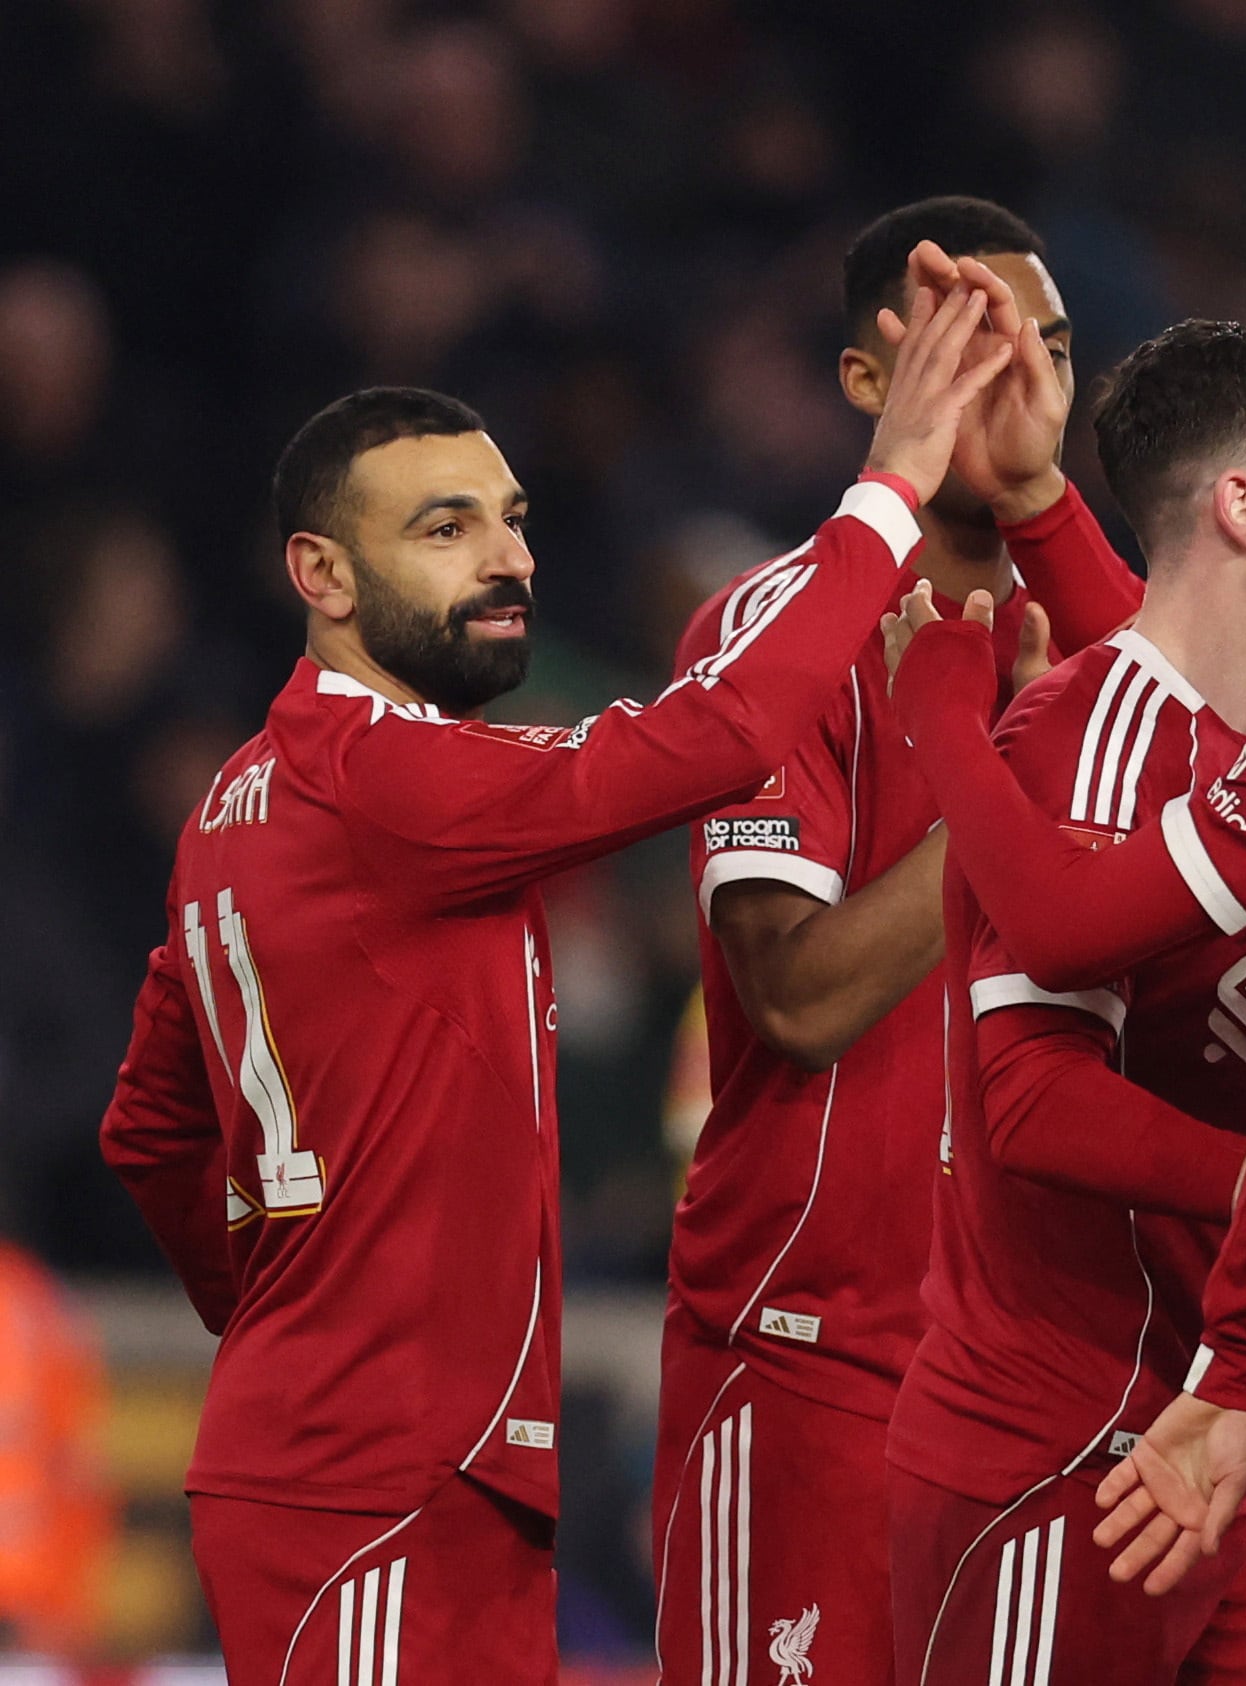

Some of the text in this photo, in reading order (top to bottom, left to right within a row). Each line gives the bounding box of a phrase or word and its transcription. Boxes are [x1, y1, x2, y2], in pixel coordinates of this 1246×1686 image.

[704, 818, 790, 836] No room
[731, 834, 800, 851] racism
